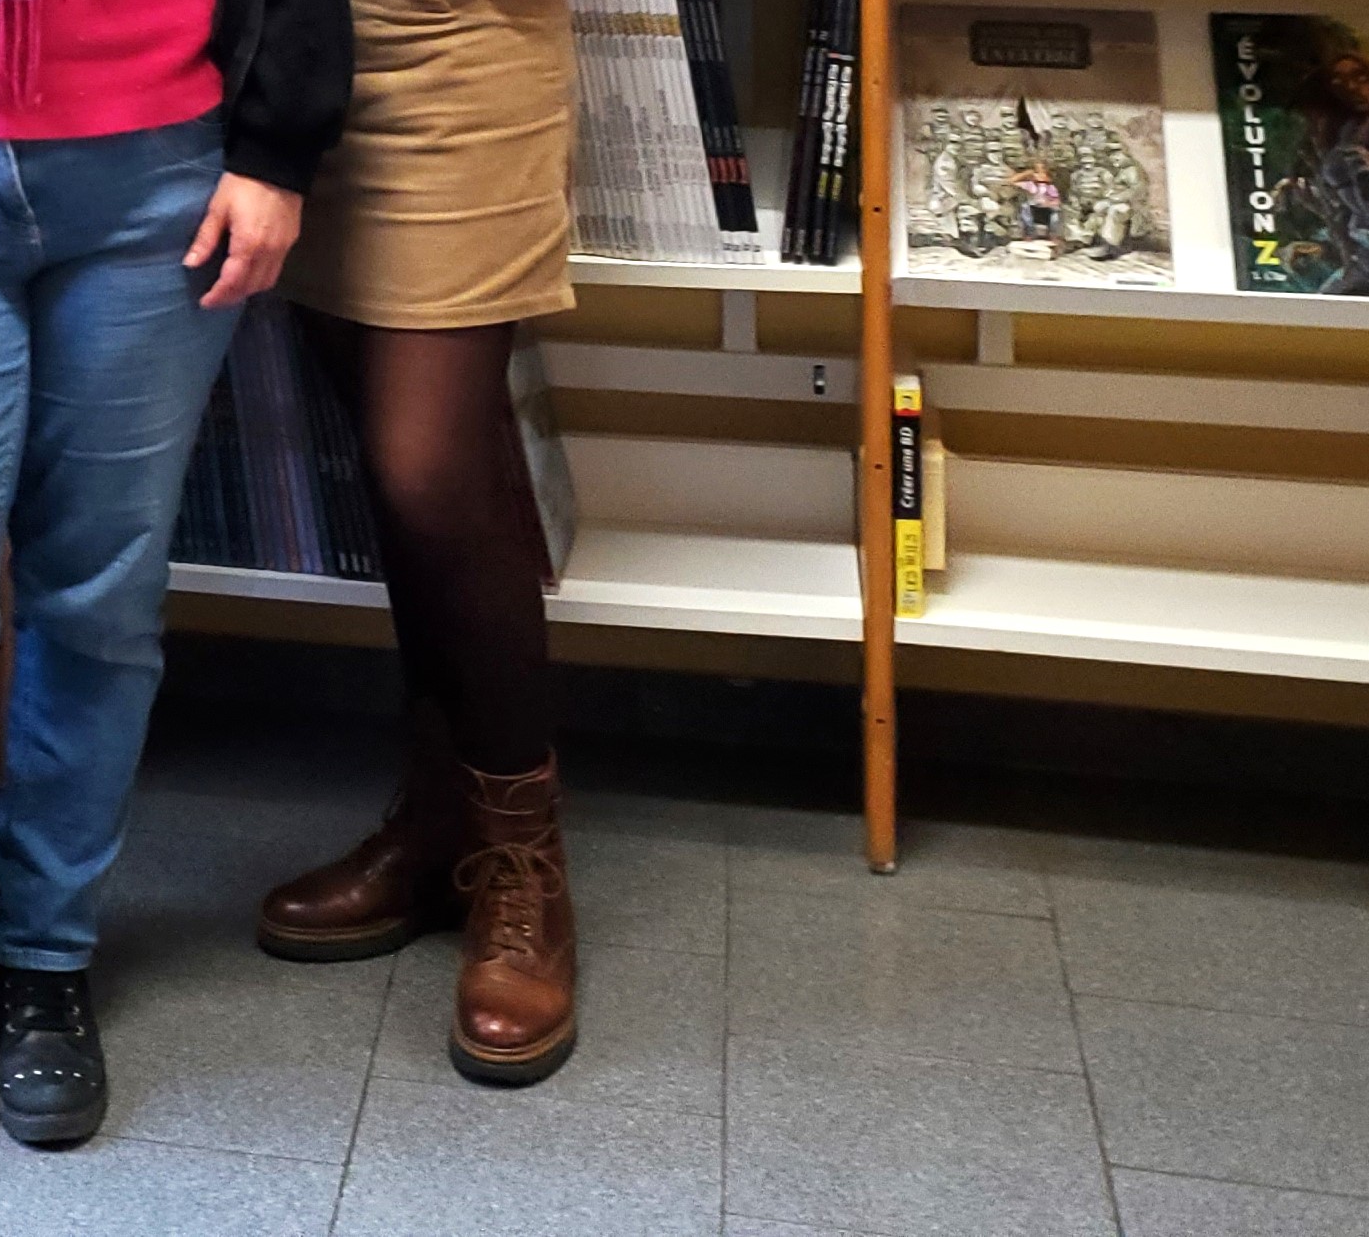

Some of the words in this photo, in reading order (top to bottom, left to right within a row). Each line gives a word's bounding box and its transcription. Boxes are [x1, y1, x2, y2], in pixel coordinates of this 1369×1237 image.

[899, 426, 915, 446] BD
[902, 449, 915, 471] une
[899, 474, 916, 509] Créer
